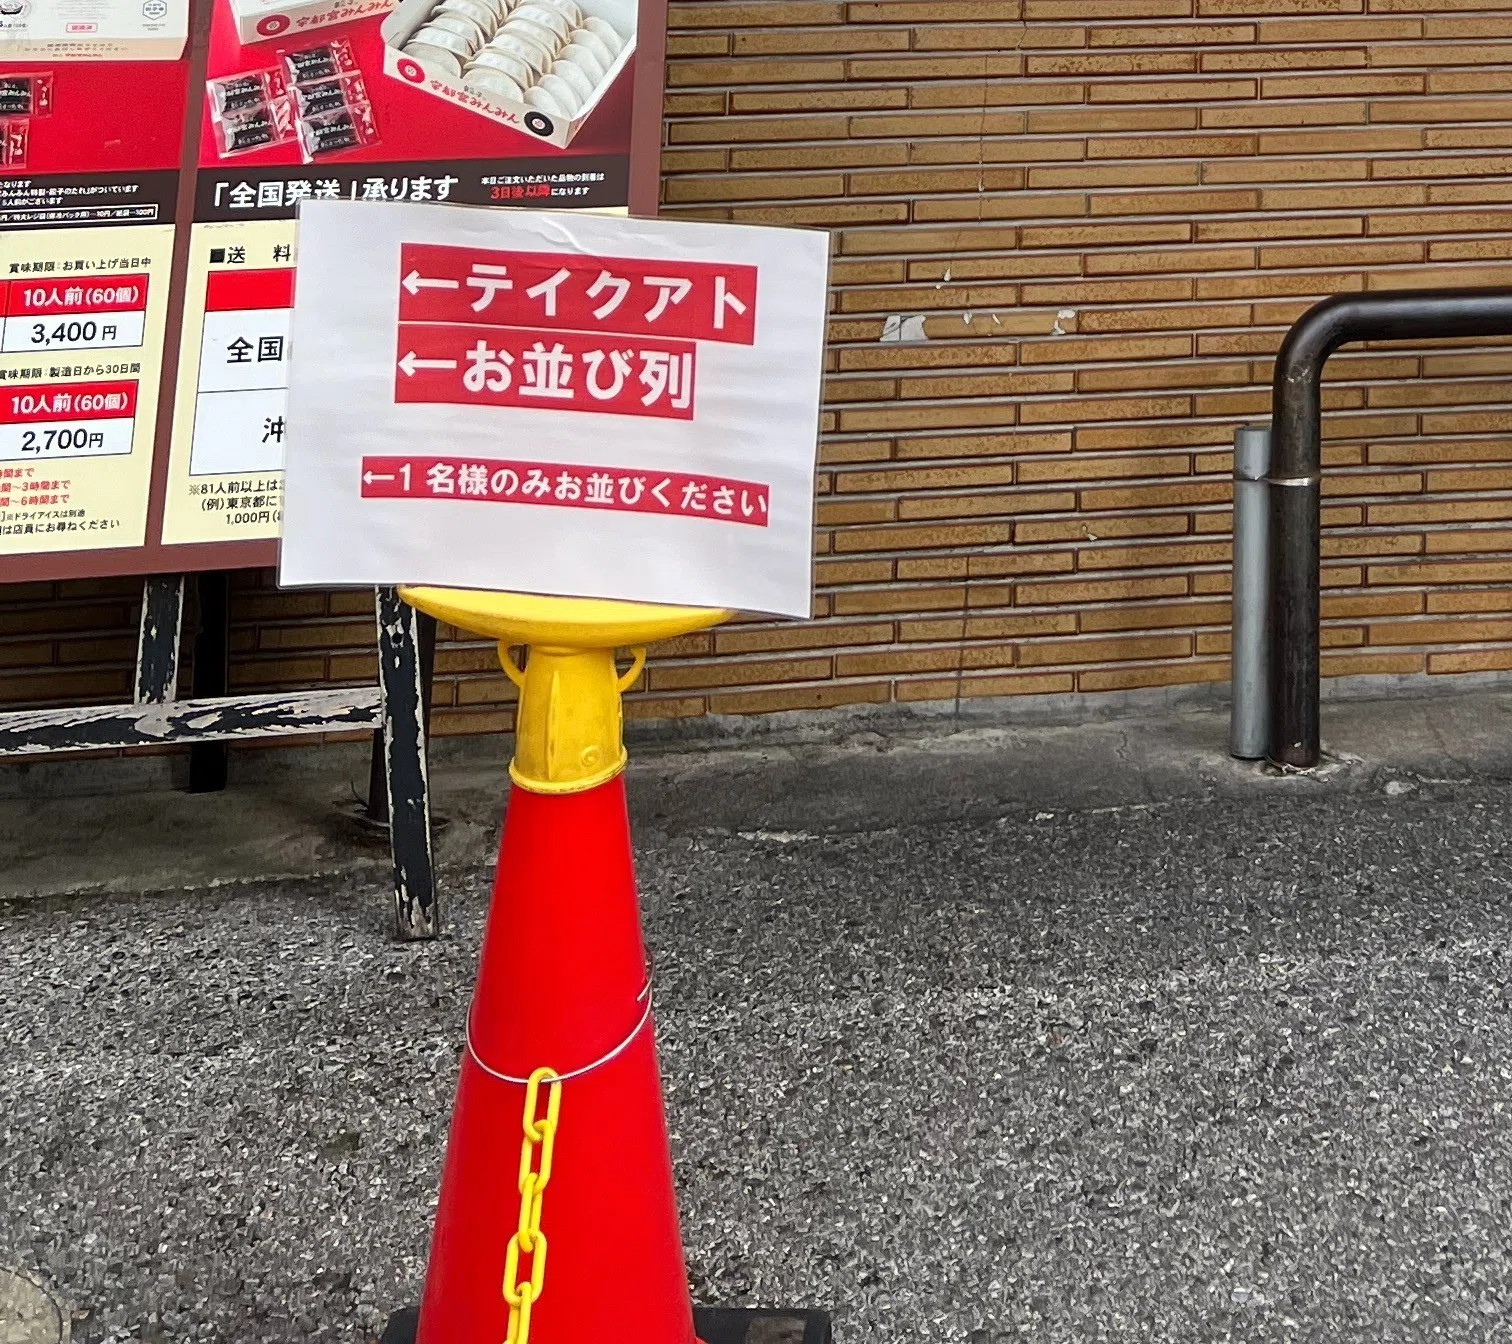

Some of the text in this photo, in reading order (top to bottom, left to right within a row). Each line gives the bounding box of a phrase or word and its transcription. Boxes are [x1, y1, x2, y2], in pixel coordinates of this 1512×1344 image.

[23, 285, 140, 307] 10人前(60個)
[466, 262, 748, 330] テイクアト
[462, 338, 694, 410] お並び列
[11, 391, 129, 416] 10人前(60個)
[21, 427, 104, 455] 2,700円
[189, 479, 285, 496] ※81人前以上は
[425, 462, 768, 518] 名様のみお並びください
[0, 519, 120, 536] は店員にお尋ねください
